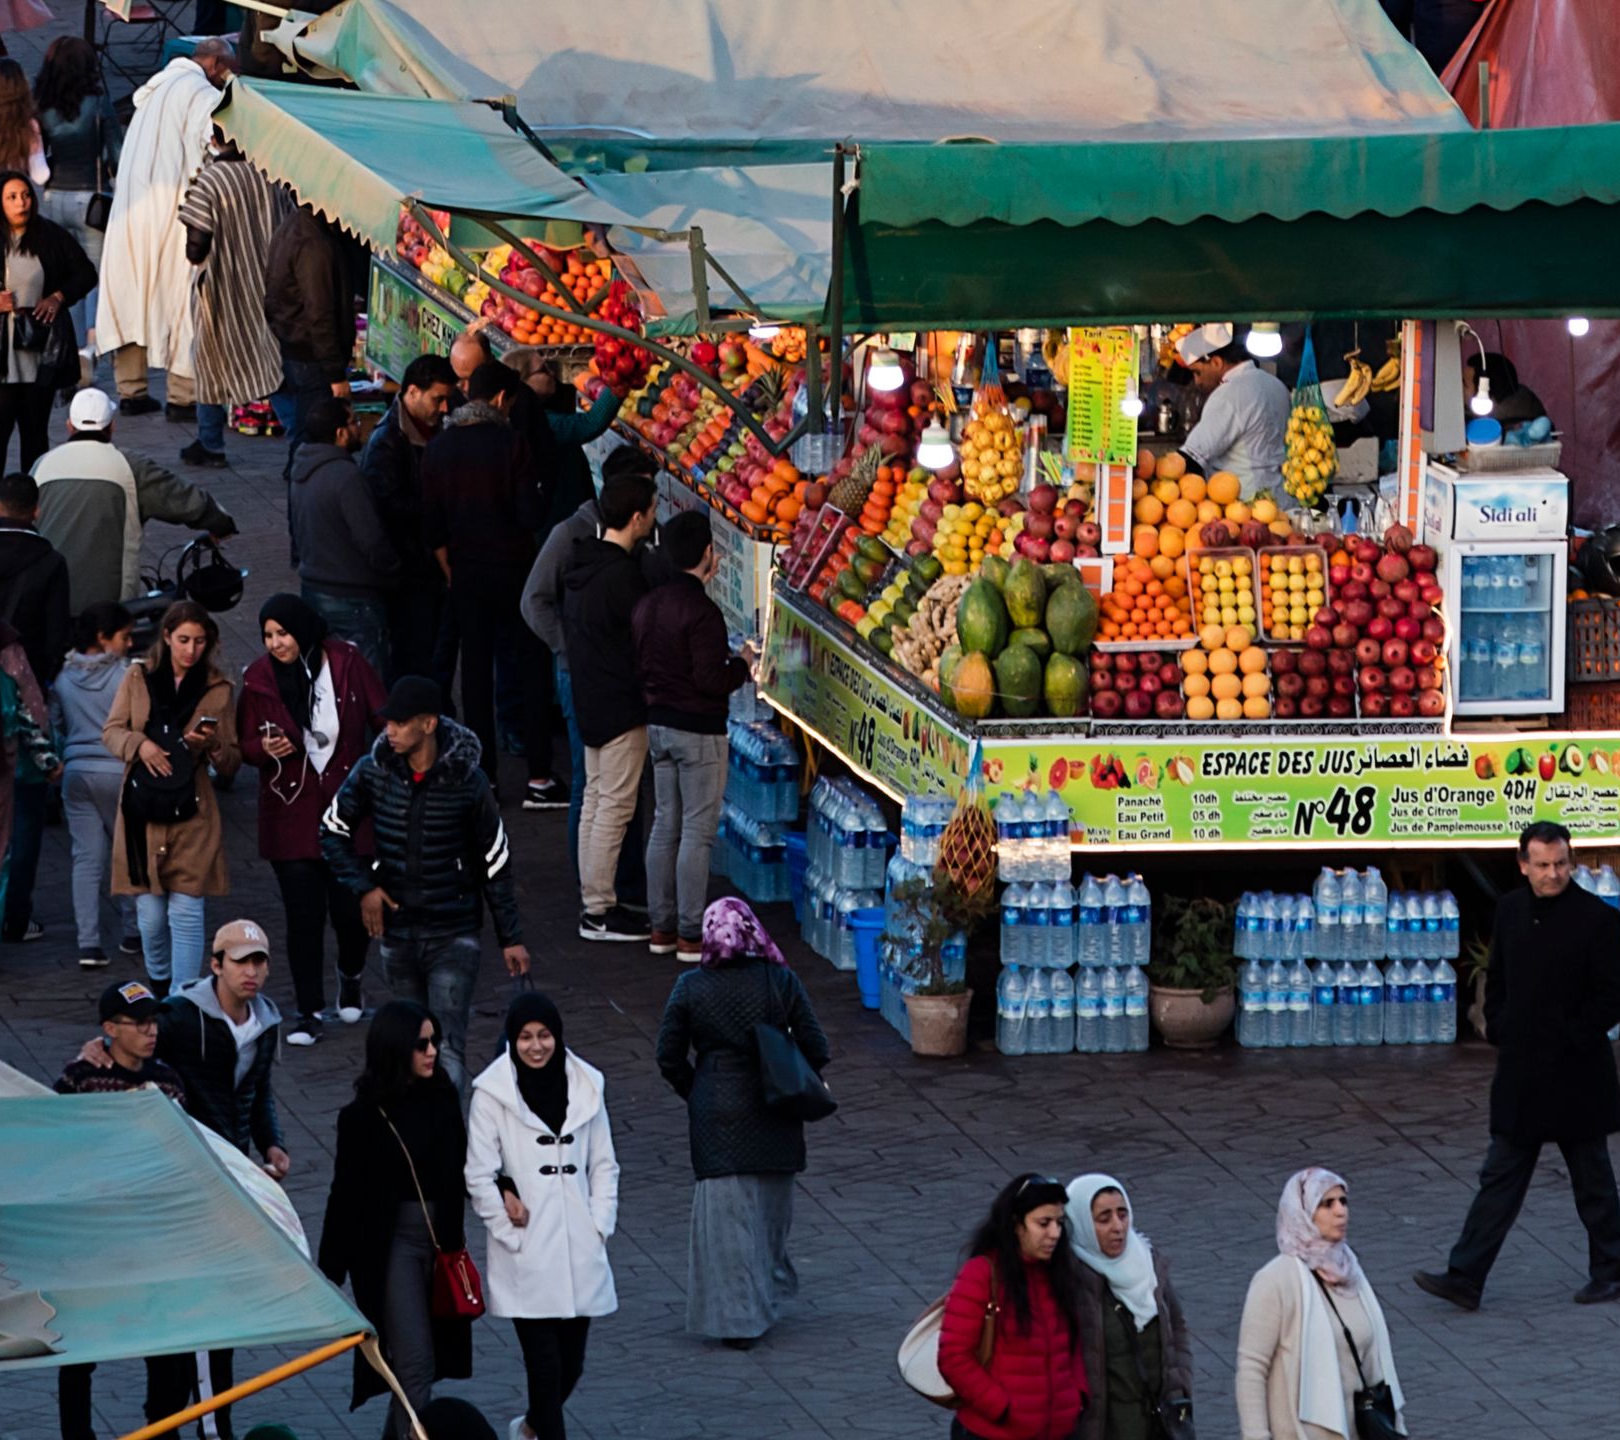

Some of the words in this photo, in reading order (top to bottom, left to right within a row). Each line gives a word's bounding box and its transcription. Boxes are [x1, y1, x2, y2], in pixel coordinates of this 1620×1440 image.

[1479, 505, 1513, 523] Sidi
[1516, 507, 1538, 522] ali
[1202, 750, 1271, 777] ESPACE
[1277, 748, 1312, 775] DES
[1318, 748, 1357, 775] JUS
[1193, 793, 1218, 805] 10dh
[1391, 787, 1421, 804] Jus
[1424, 786, 1496, 807] d'Orange
[1503, 780, 1537, 801] 4DH
[1118, 810, 1138, 823] Eau
[1139, 810, 1165, 823] Petit
[1192, 810, 1207, 822] 05
[1208, 810, 1221, 821] dh
[1390, 806, 1407, 817] Jus
[1410, 806, 1424, 817] de
[1427, 806, 1459, 817] Citron
[1509, 806, 1533, 817] 10hd
[1118, 828, 1138, 840] Eau
[1140, 828, 1172, 840] Grand
[1193, 827, 1206, 839] 10
[1208, 827, 1221, 839] dh
[1390, 822, 1406, 833] Jus
[1409, 822, 1424, 833] de
[1427, 821, 1504, 834] Pamplemousse
[243, 926, 260, 942] NY
